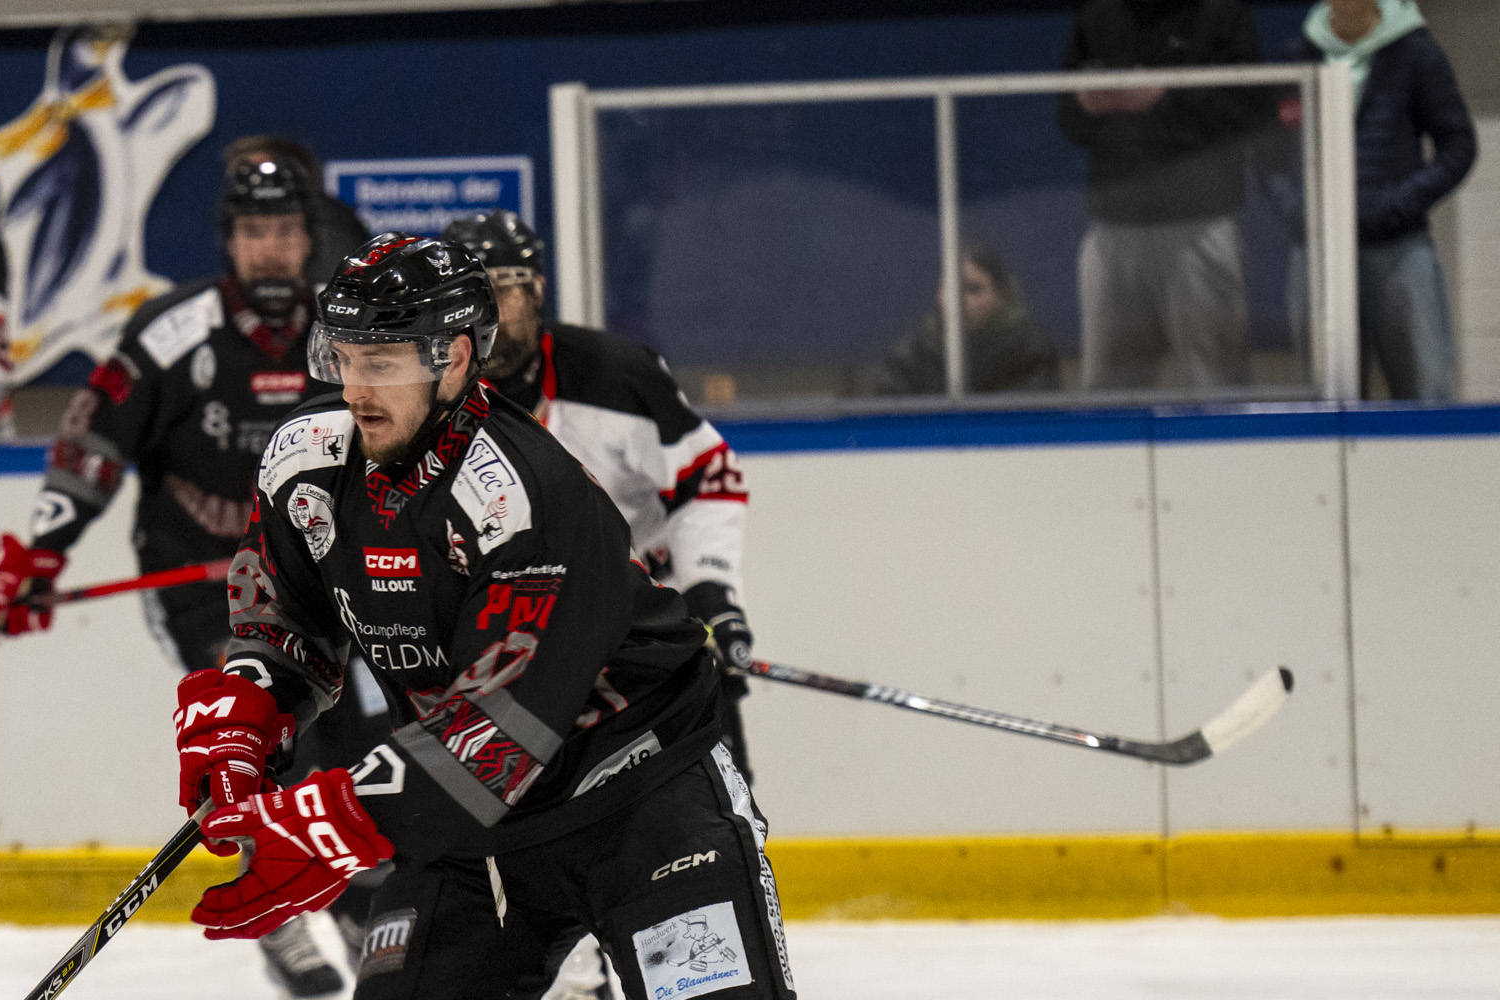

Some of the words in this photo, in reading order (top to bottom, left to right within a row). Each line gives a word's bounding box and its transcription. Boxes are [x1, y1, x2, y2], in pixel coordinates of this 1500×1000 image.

[327, 303, 360, 315] CCM
[443, 304, 475, 323] CCM
[365, 554, 417, 570] CCM
[371, 579, 389, 592] ALL
[388, 579, 417, 592] OUT.
[357, 621, 428, 640] Baumpflege
[364, 643, 451, 671] ELDM
[217, 730, 245, 741] XF
[246, 733, 262, 745] 80
[220, 770, 235, 803] CCM
[294, 783, 370, 879] CCM
[651, 850, 719, 881] CCM
[105, 873, 159, 938] CCM
[641, 921, 678, 949] Handwerk
[61, 960, 75, 978] 2.0
[655, 985, 674, 1000] Die
[675, 967, 740, 992] Blaumänner
